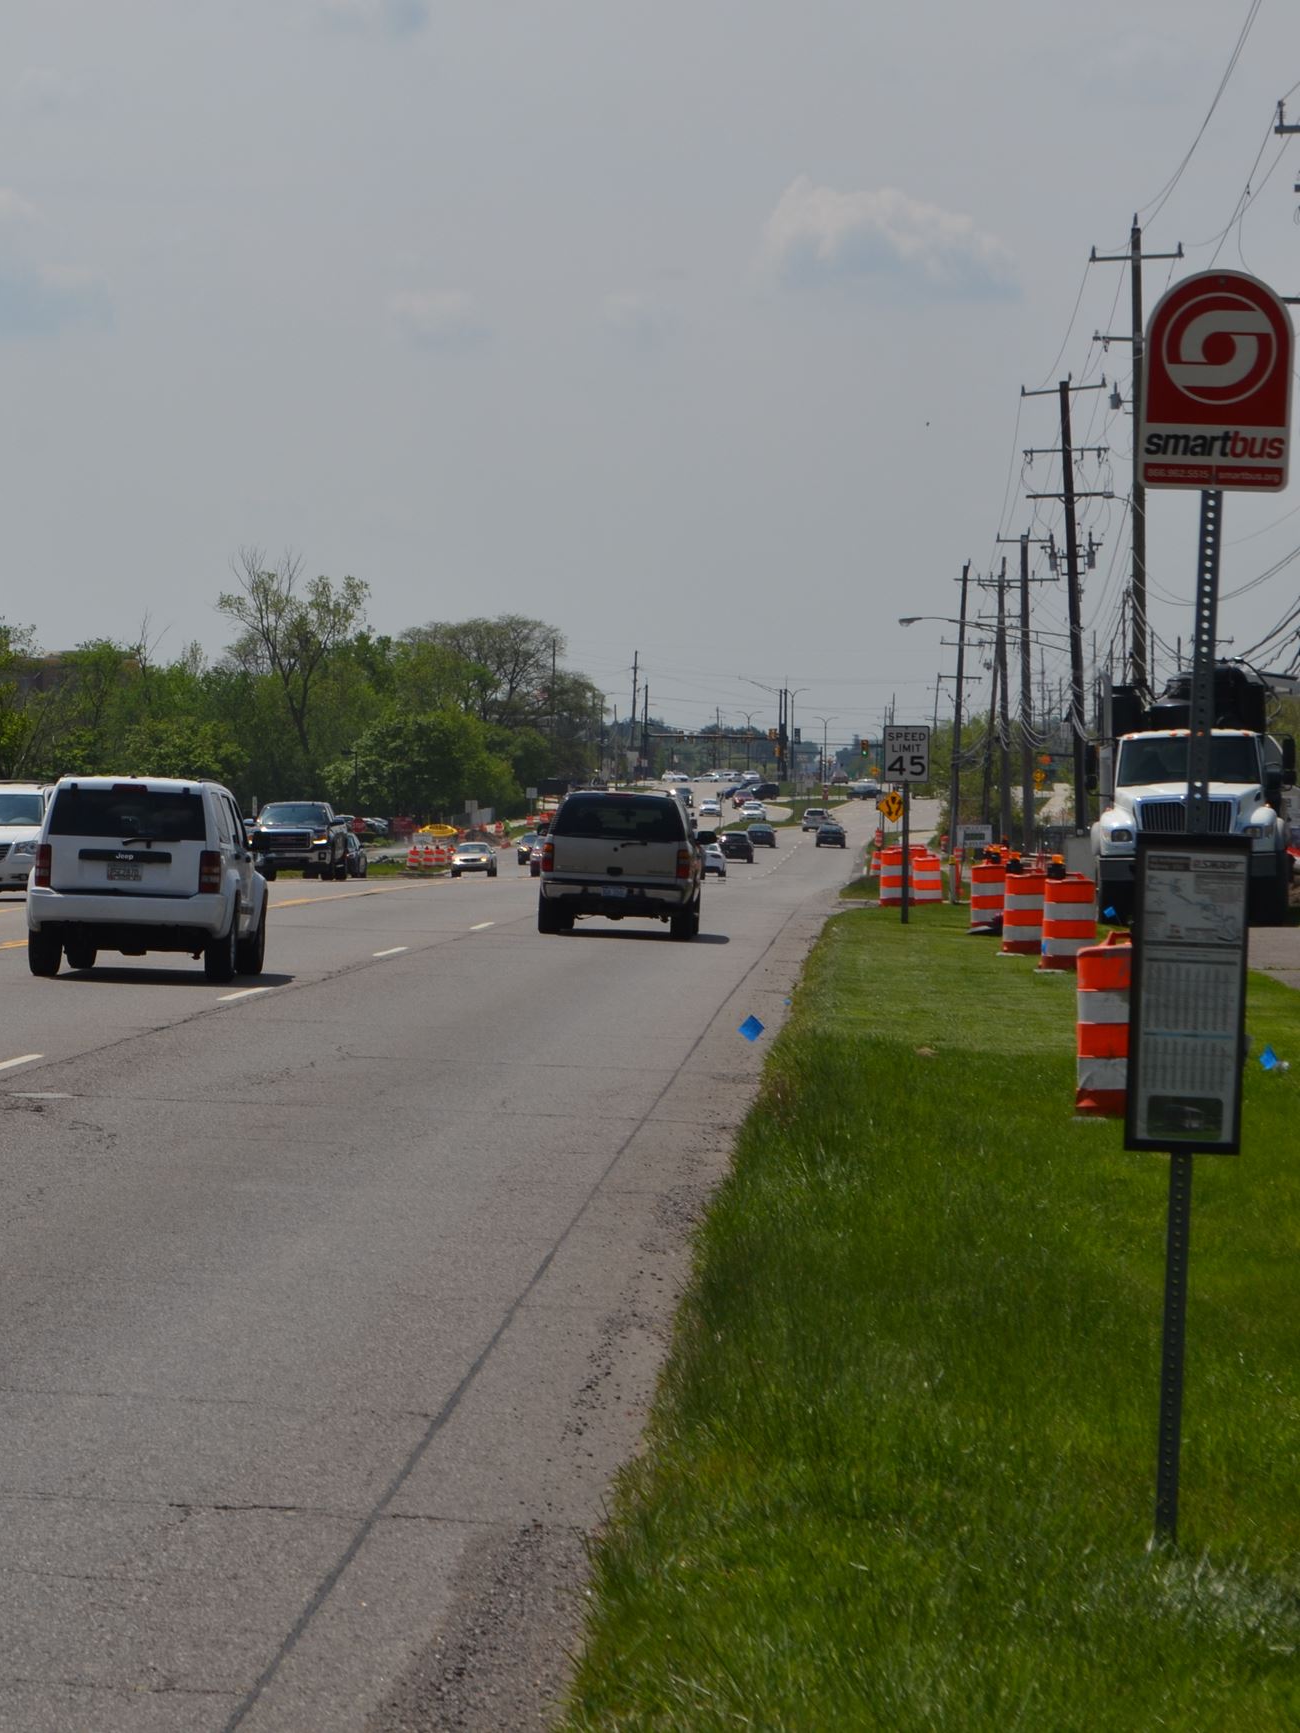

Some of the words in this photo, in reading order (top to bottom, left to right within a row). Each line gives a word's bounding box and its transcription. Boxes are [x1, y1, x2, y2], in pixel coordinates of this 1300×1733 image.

[1144, 430, 1285, 459] smartbus
[887, 732, 926, 741] SPEED
[892, 744, 921, 752] LIMIT
[887, 756, 926, 776] 45
[115, 852, 134, 860] Jeep
